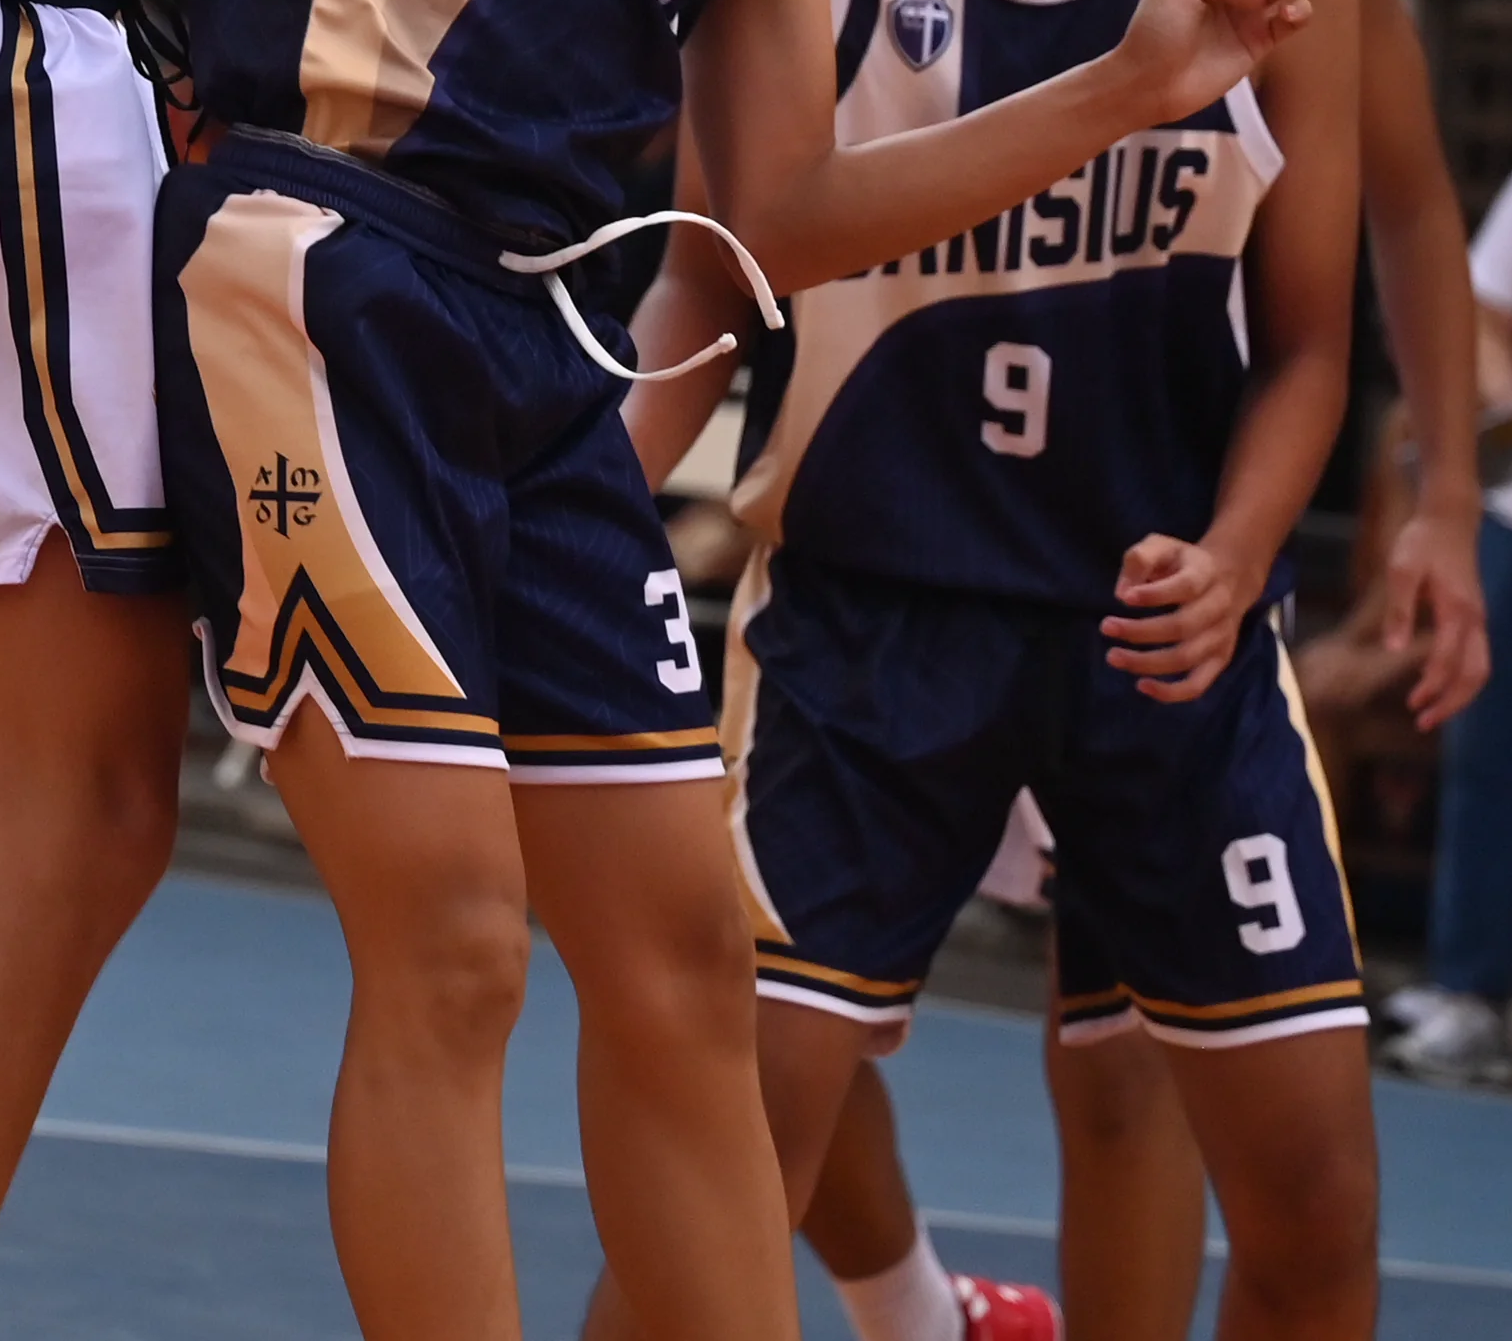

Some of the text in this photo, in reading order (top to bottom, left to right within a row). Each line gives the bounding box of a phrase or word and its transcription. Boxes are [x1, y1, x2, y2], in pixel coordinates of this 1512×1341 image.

[979, 341, 1052, 458] 9
[643, 568, 703, 695] 3
[1221, 832, 1307, 956] 9
